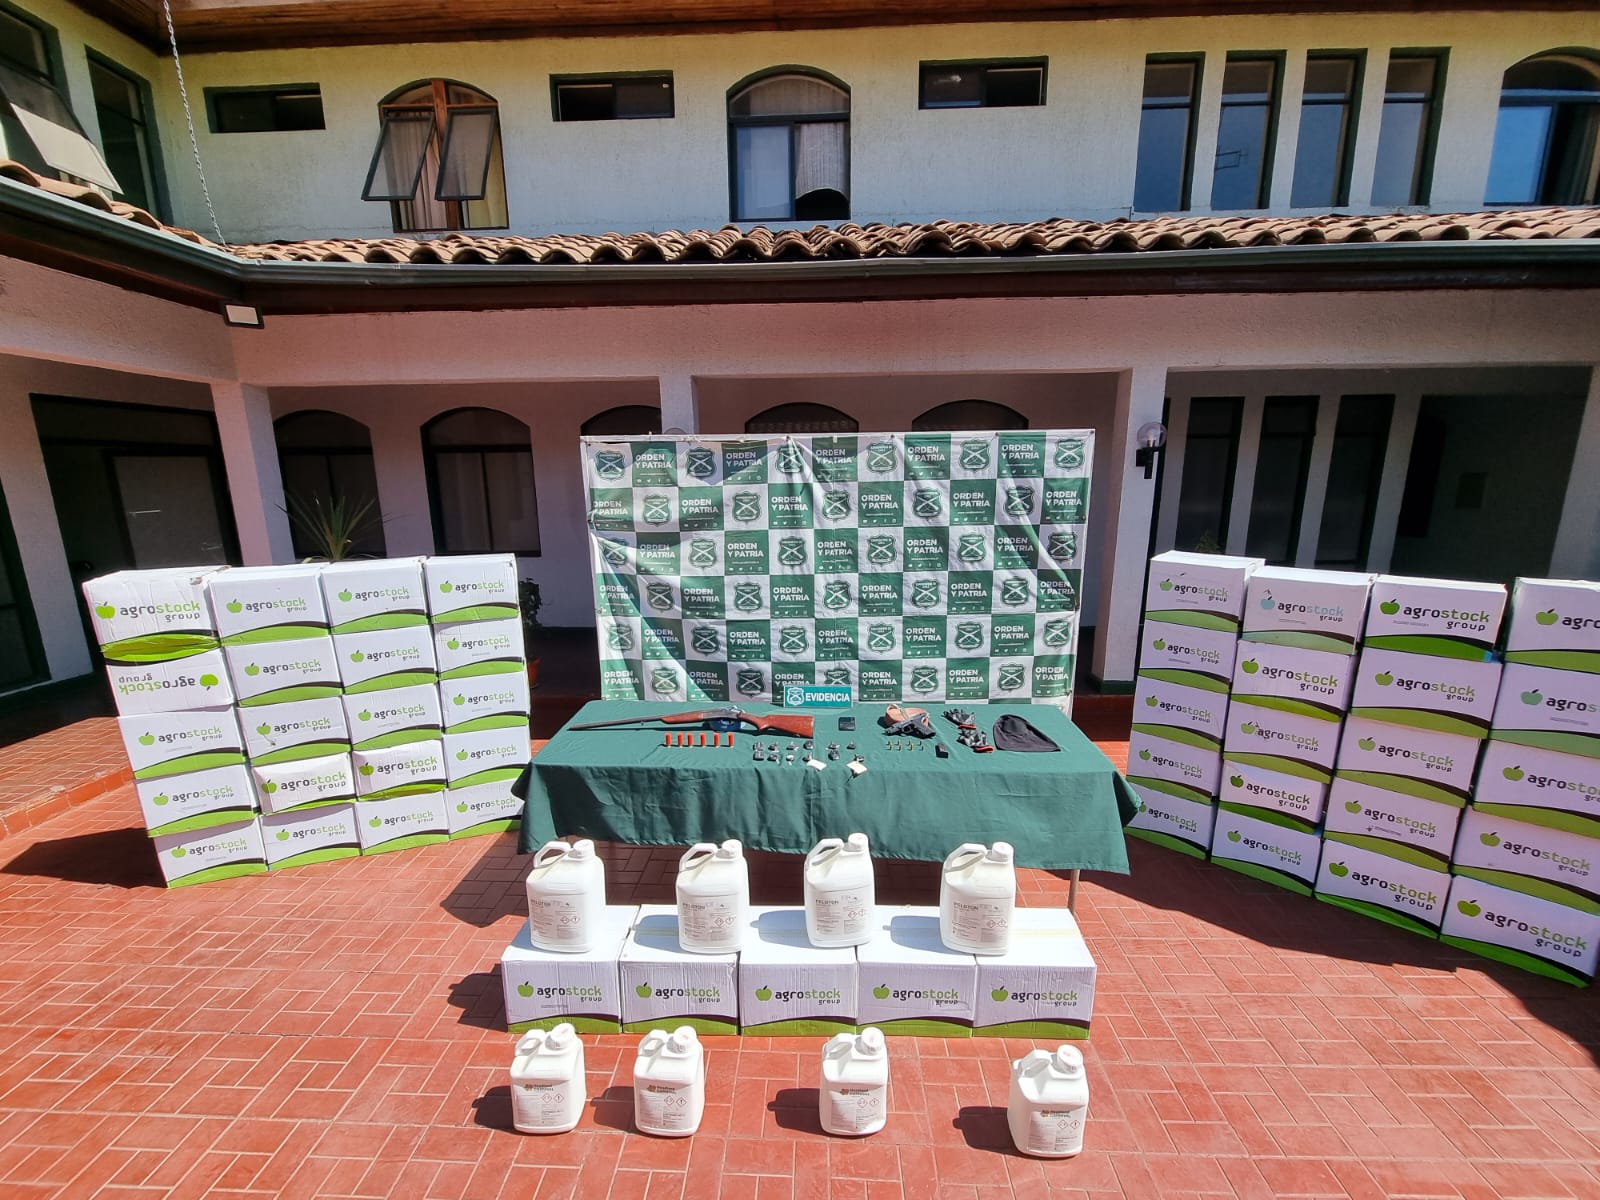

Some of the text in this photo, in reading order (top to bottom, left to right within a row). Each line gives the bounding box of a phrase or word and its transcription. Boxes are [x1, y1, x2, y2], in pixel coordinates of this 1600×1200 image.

[355, 586, 409, 600] agrostock
[455, 580, 504, 594] agrostock
[1174, 584, 1228, 596] agrostock
[120, 601, 200, 618] agrostock
[246, 598, 306, 611] agrostock
[1278, 601, 1344, 617] agrostock
[166, 612, 200, 622] group
[1404, 606, 1490, 622] agrostock
[1447, 621, 1485, 631] group
[462, 635, 510, 650] agrostock
[366, 646, 420, 661] agrostock
[1168, 644, 1220, 659] agrostock
[262, 658, 321, 675] agrostock
[118, 673, 152, 684] group
[1262, 666, 1338, 687] agrostock
[120, 676, 195, 694] agrostock
[1300, 683, 1334, 695] group
[1397, 678, 1475, 697] agrostock
[468, 690, 515, 705] agrostock
[806, 693, 850, 702] EVIDENCIA
[1447, 694, 1474, 702] group
[1546, 696, 1600, 711] agros
[374, 704, 424, 720] agrostock
[1160, 701, 1211, 718] agrostock
[274, 717, 330, 733] agrostock
[158, 726, 222, 743] agrostock
[1258, 728, 1319, 746] agrostock
[471, 745, 516, 760] agrostock
[1297, 743, 1318, 751] group
[1379, 744, 1453, 766] agrostock
[377, 756, 437, 774] agrostock
[410, 765, 437, 775] group
[1152, 756, 1202, 774] agrostock
[1426, 762, 1452, 772] group
[1184, 770, 1201, 778] group
[280, 772, 346, 792] agrostock
[318, 781, 346, 791] group
[1528, 774, 1600, 795] agrosto
[172, 785, 233, 802] agrostock
[1246, 783, 1310, 804] agrostock
[470, 797, 515, 812] agrostock
[1278, 800, 1307, 811] group
[384, 810, 432, 827] agrostock
[1148, 808, 1197, 828] agrostock
[1364, 808, 1436, 832] agrostock
[292, 822, 345, 839] agrostock
[1179, 824, 1196, 832] group
[1410, 827, 1435, 838] group
[189, 838, 246, 856] agrostock
[1243, 838, 1302, 860] agrostock
[1280, 856, 1300, 865] group
[1503, 840, 1591, 870] agrostock
[1558, 864, 1588, 876] group
[1352, 871, 1437, 904] agrostock
[1394, 894, 1433, 911] group
[1485, 911, 1587, 950] agrostock
[1535, 938, 1582, 958] group
[537, 986, 601, 998] agrostock
[656, 986, 720, 999] agrostock
[775, 988, 840, 1002] agrostock
[893, 988, 958, 1001] agrostock
[1011, 990, 1078, 1002] agrostock
